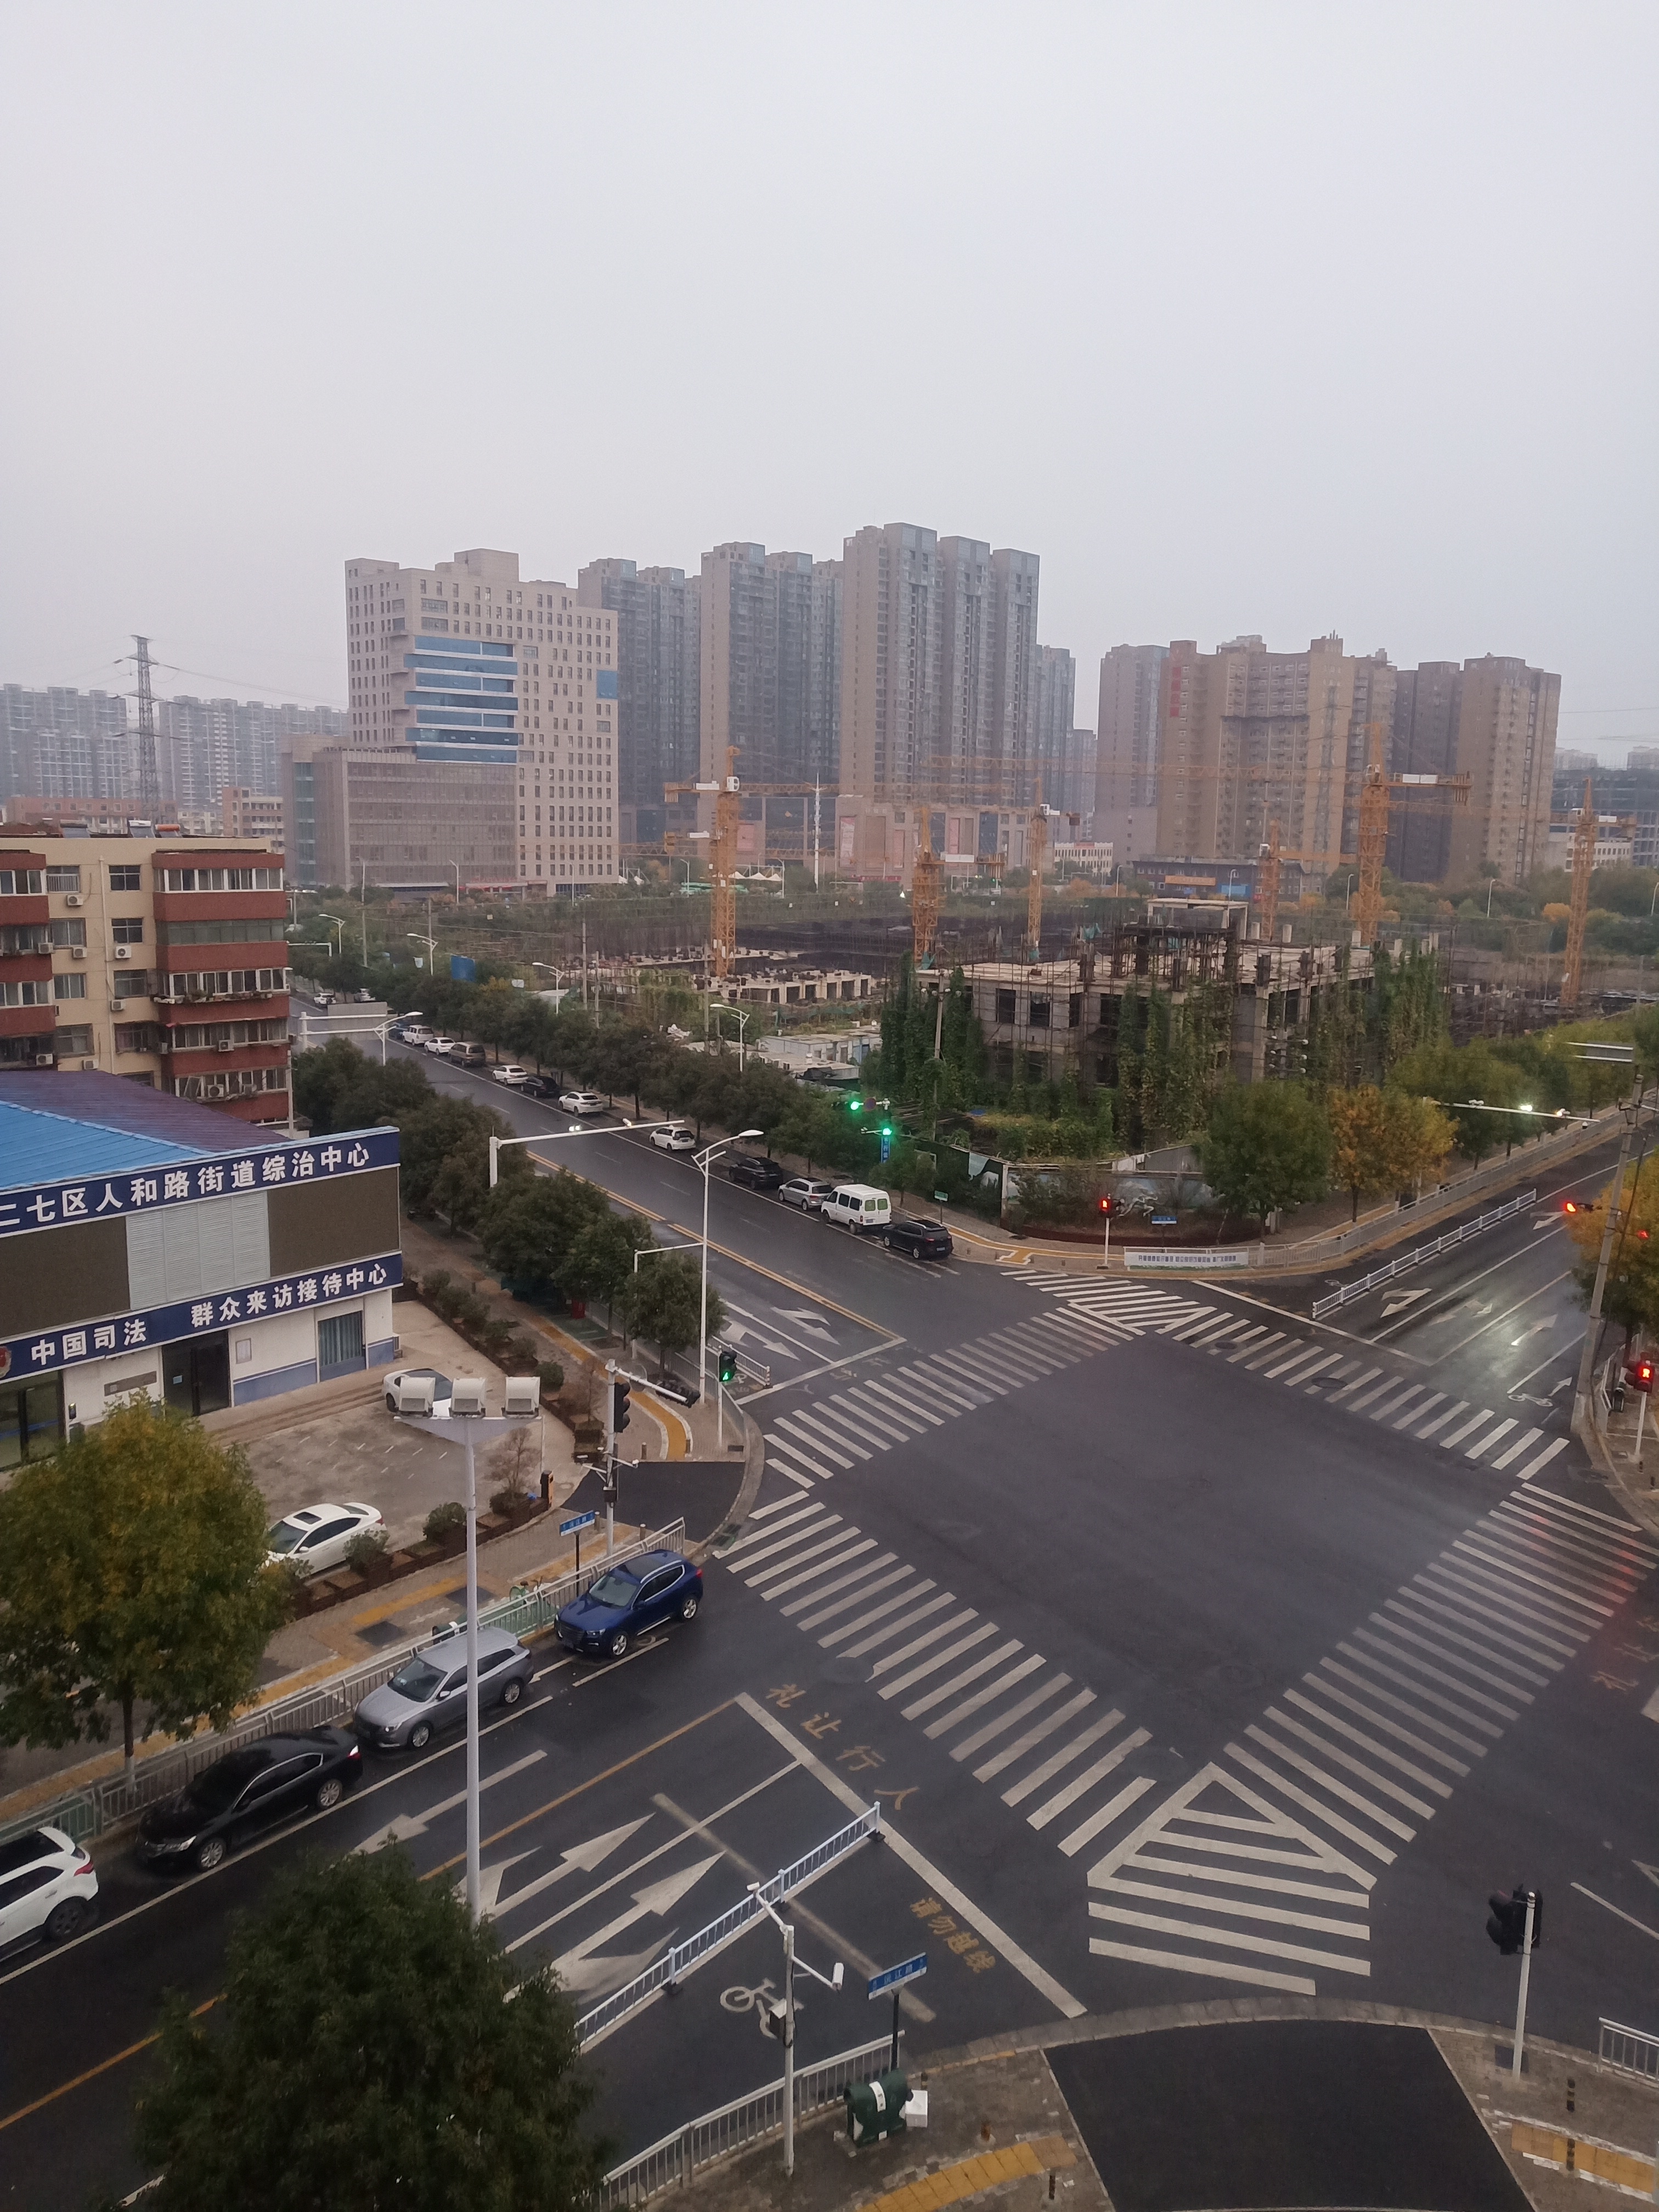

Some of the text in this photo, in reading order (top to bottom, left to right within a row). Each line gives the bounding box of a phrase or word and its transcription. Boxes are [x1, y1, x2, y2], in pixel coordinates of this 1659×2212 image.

[0, 1142, 370, 1227] 二七区人和路街道综治中心
[31, 1263, 388, 1367] 中国司法 群众来访接待中心
[766, 1683, 920, 1810] 礼让行人
